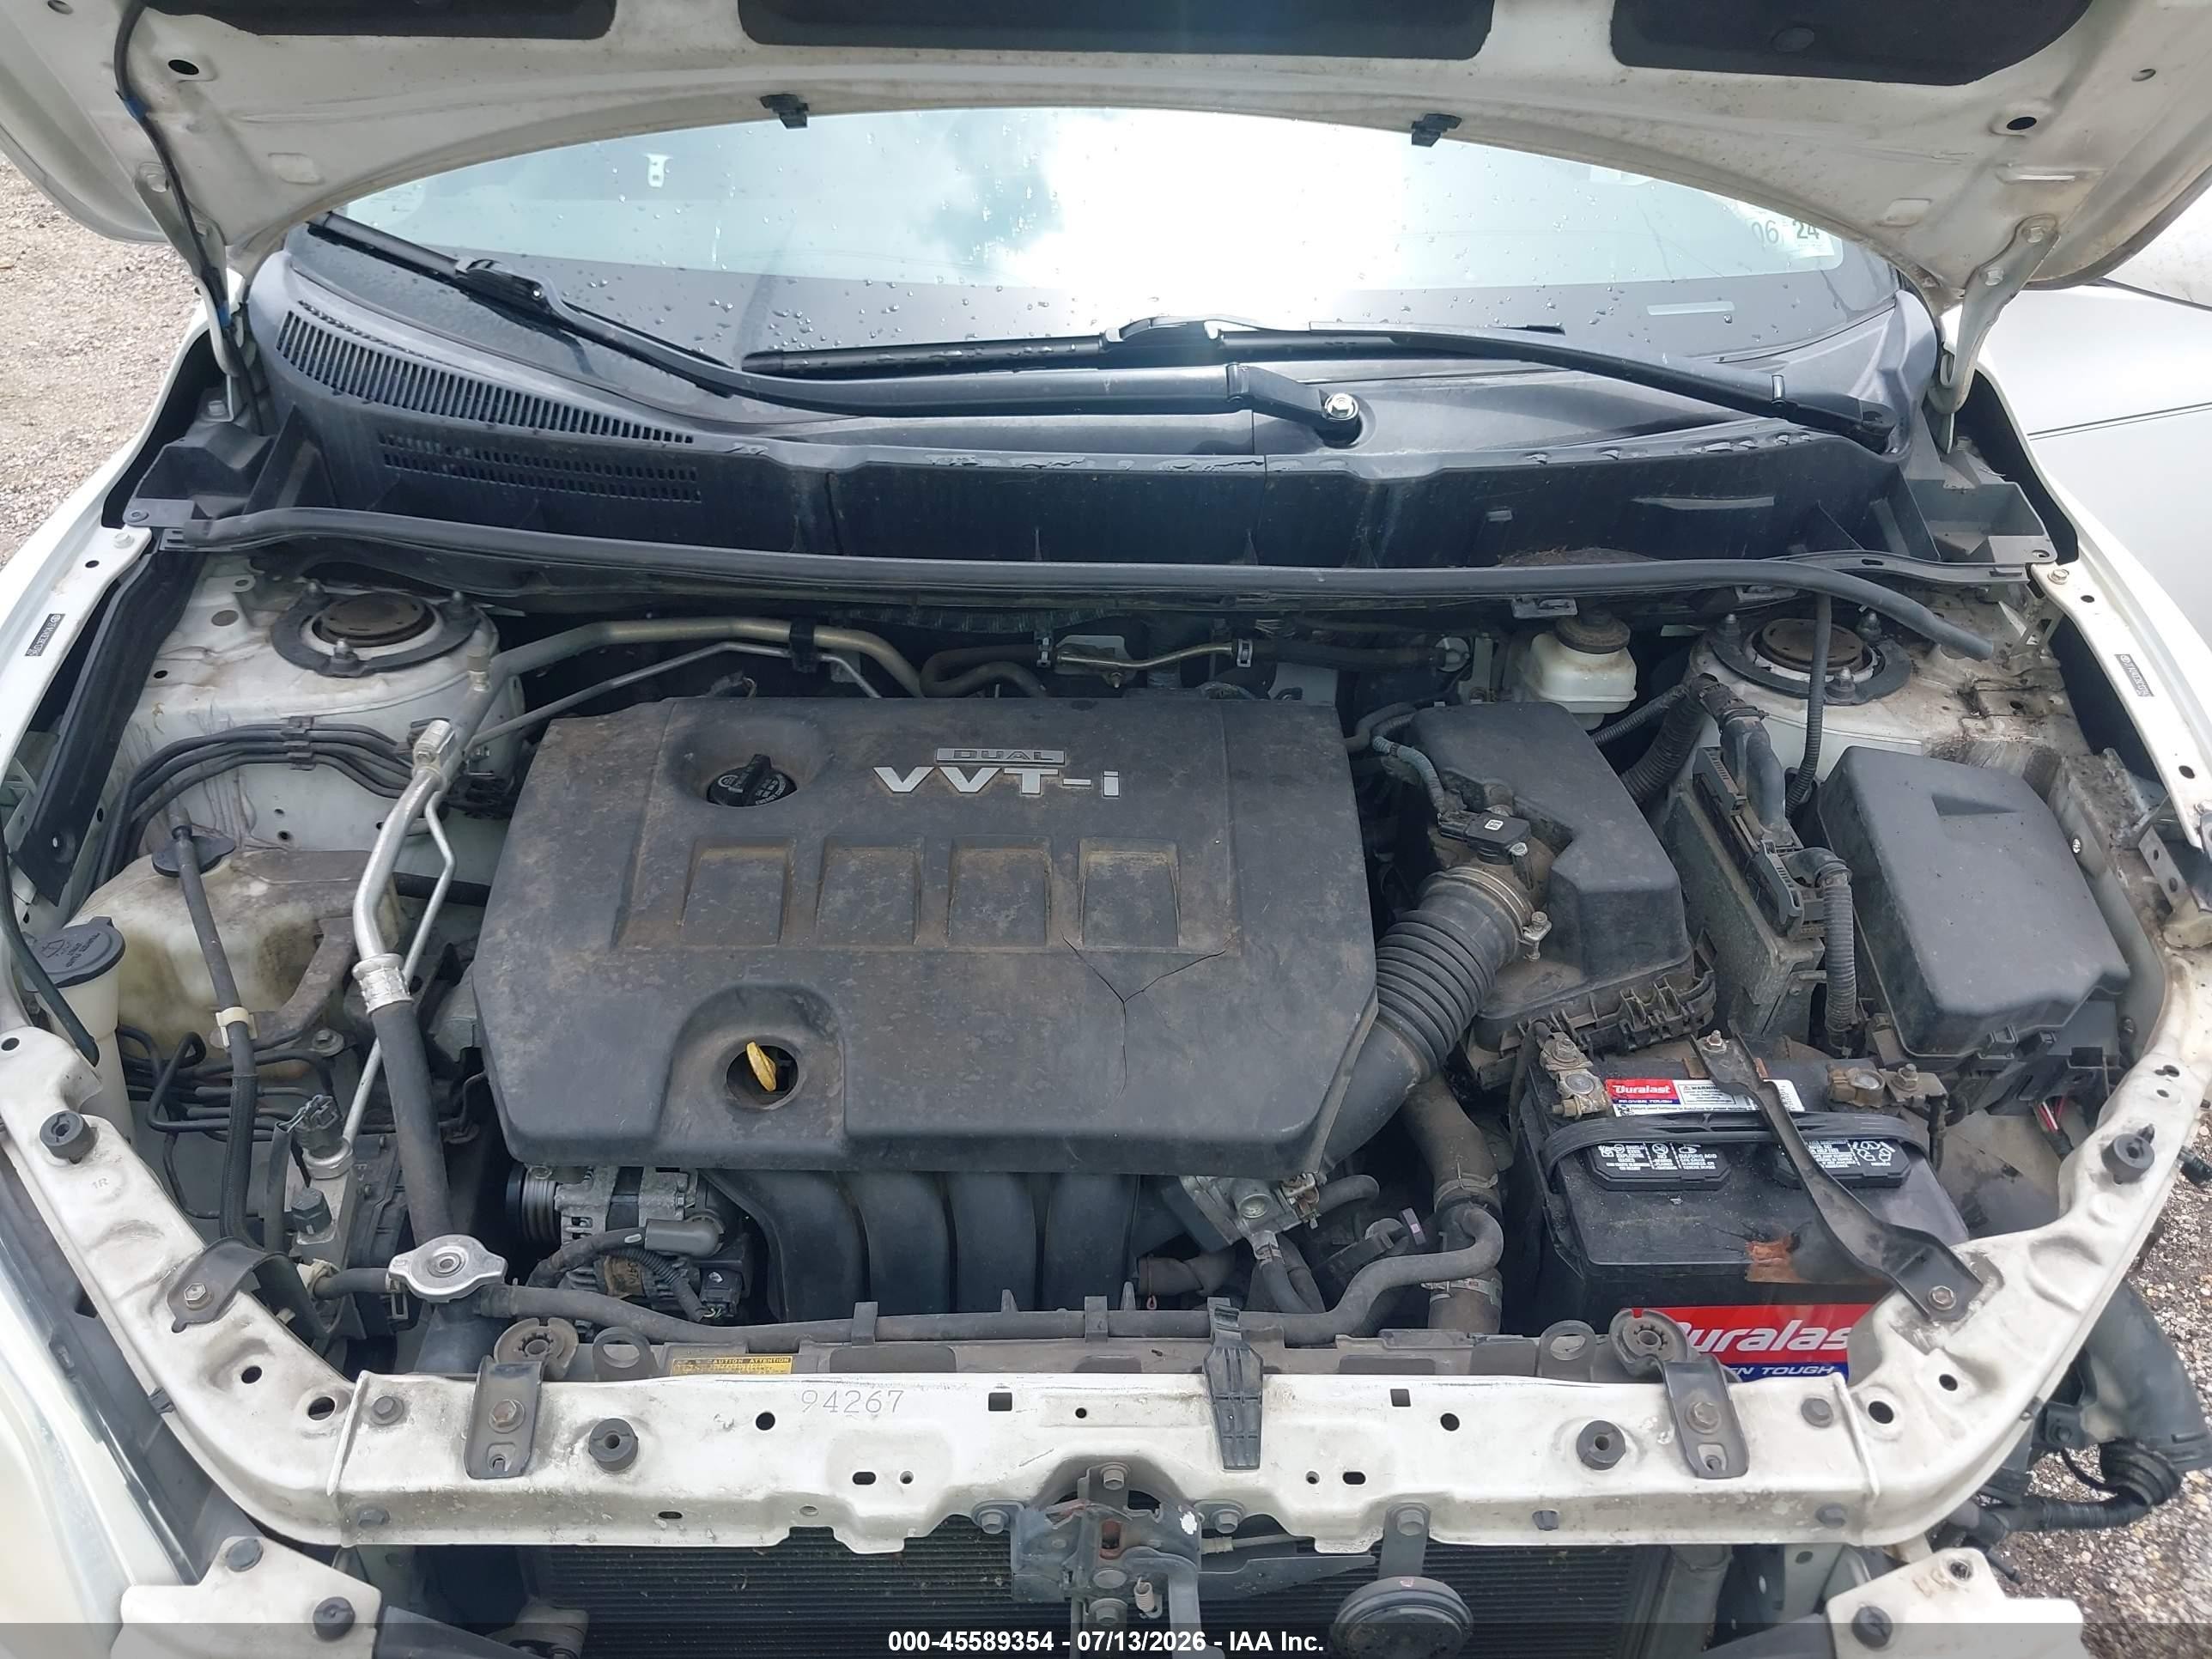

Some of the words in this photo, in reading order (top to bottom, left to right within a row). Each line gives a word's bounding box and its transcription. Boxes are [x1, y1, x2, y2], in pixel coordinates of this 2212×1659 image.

[953, 750, 1054, 760] DUAL
[873, 766, 1120, 797] VVT-i
[1613, 1085, 1671, 1093] Duralast
[1761, 1365, 1835, 1375] TOUGH
[801, 1389, 904, 1413] 94267
